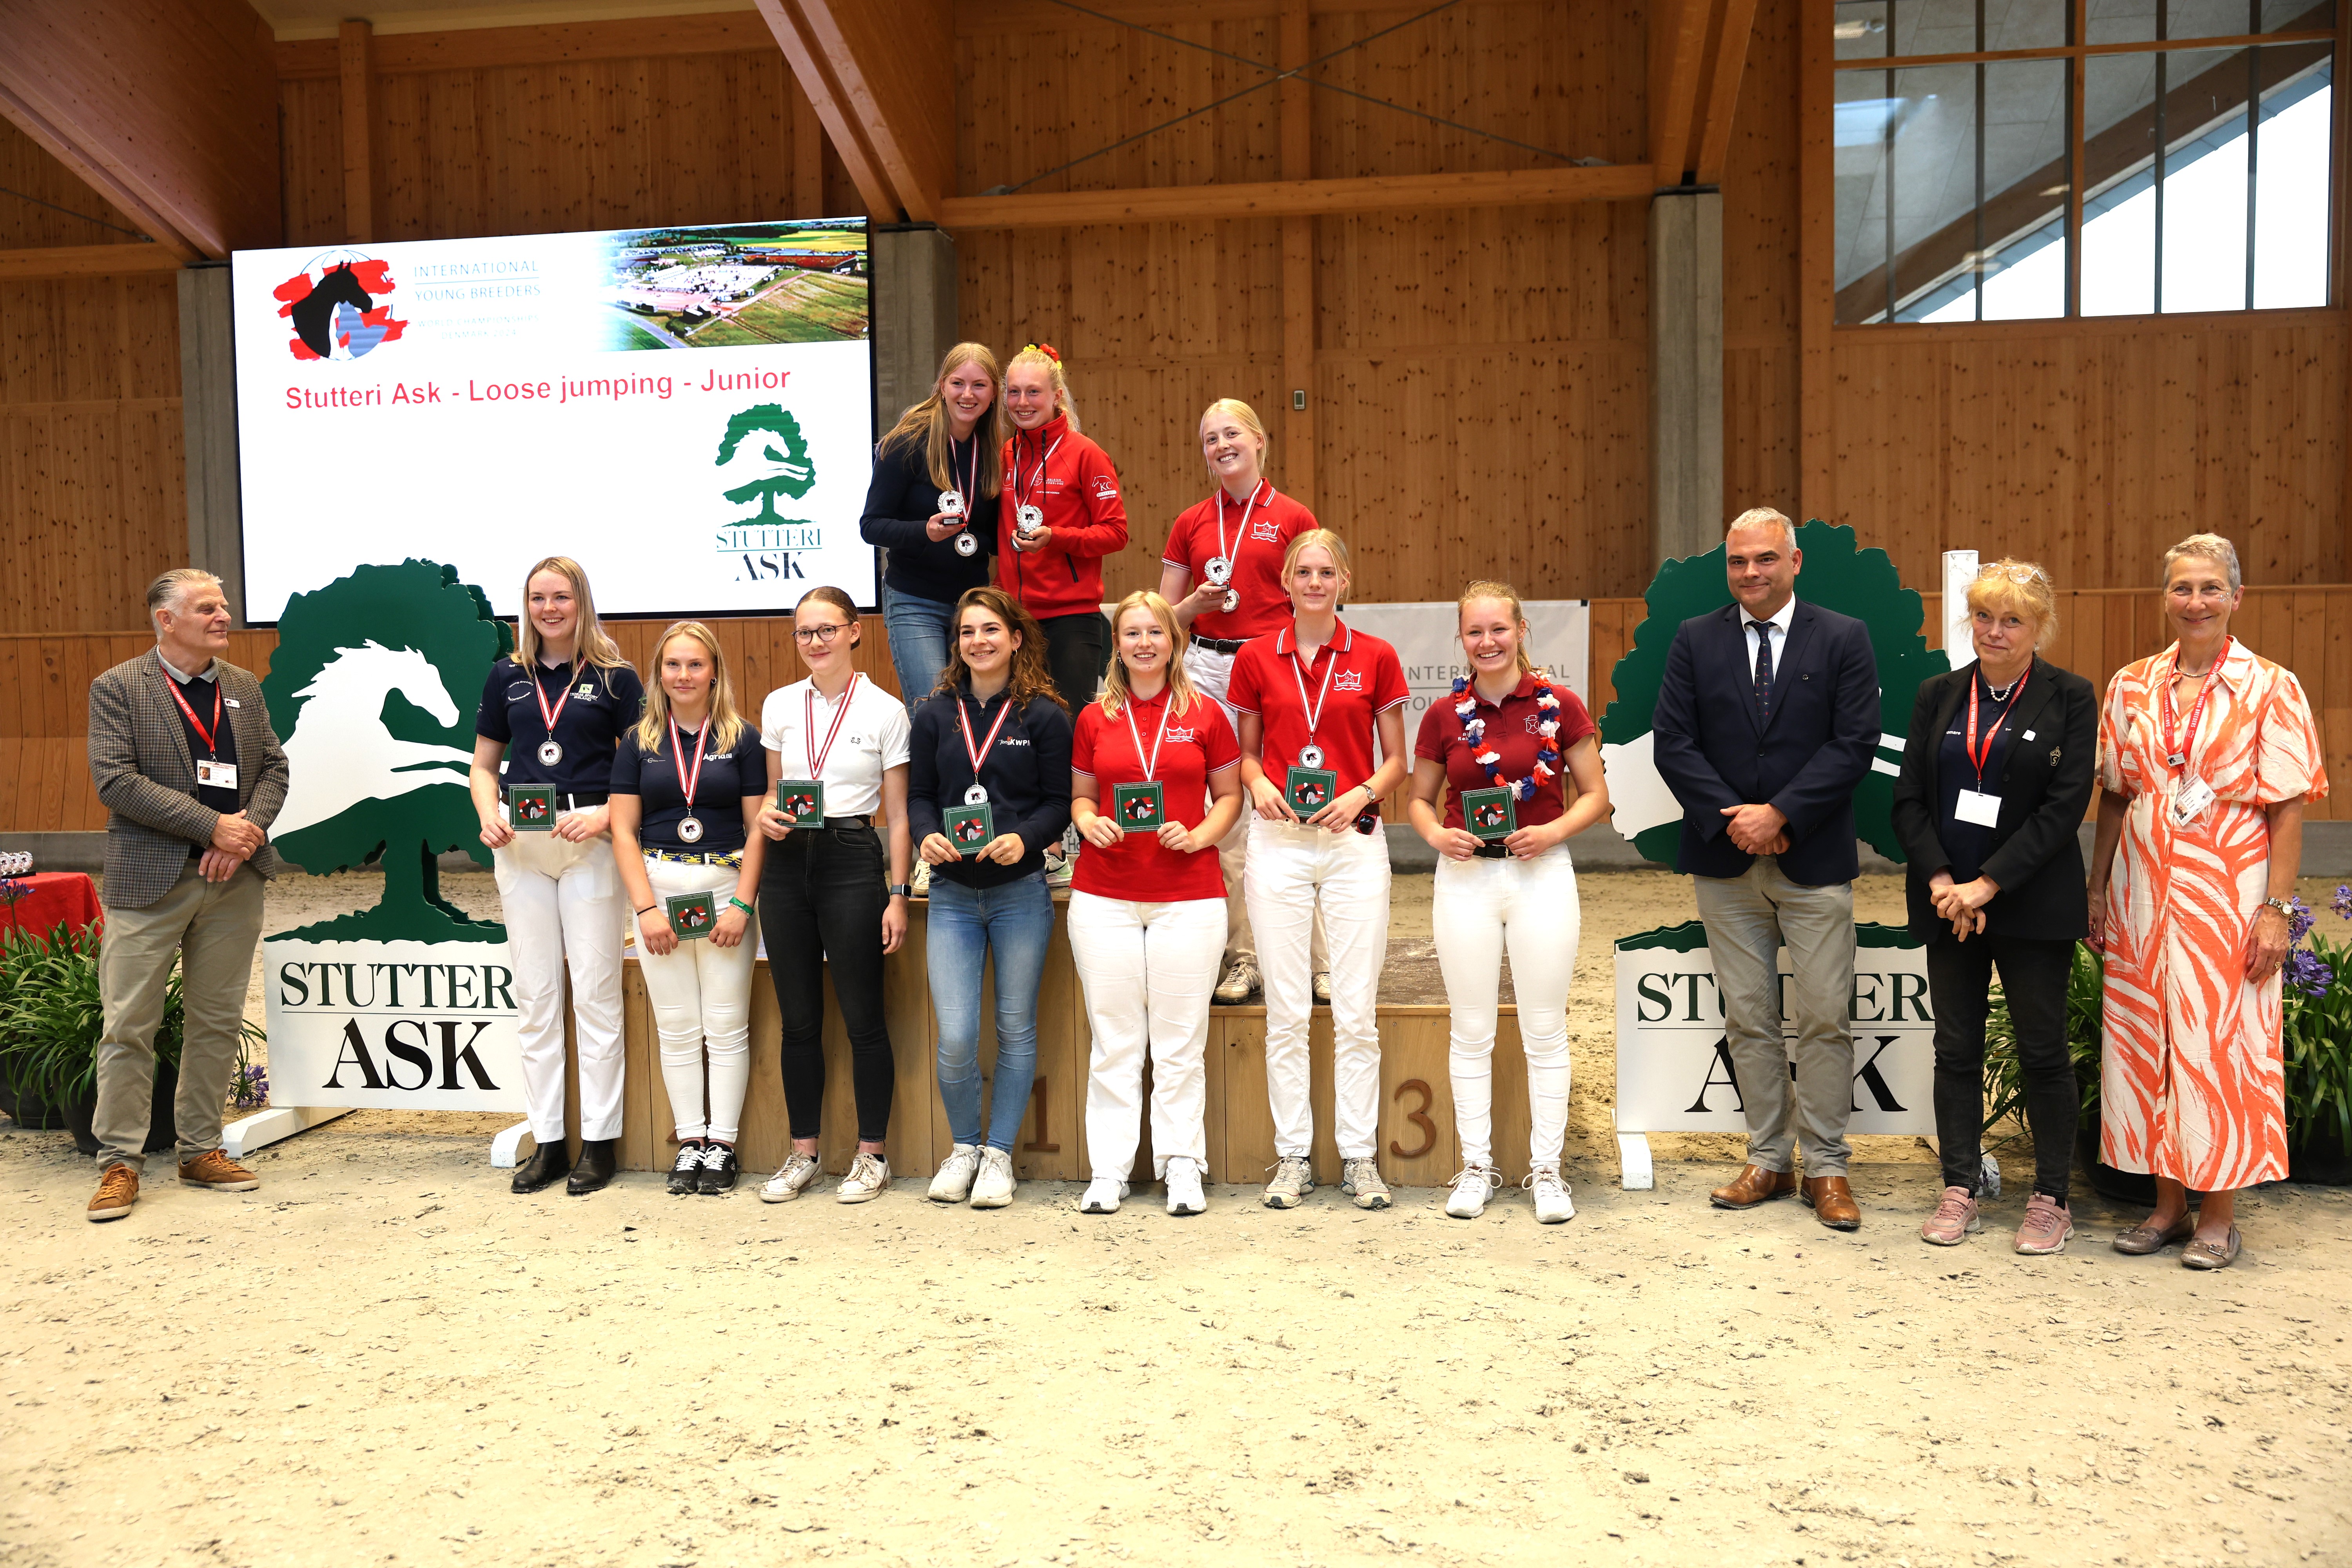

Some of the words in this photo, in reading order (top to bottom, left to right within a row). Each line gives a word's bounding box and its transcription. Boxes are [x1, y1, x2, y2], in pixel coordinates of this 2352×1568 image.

[415, 261, 538, 277] INTERNATIONAL
[415, 289, 465, 301] YOUNG
[471, 285, 540, 299] BREEDERS
[457, 314, 539, 326] CHAMPIONSHIPS
[442, 331, 489, 339] DENMARK
[287, 384, 381, 409] Stutteri
[392, 381, 441, 405] Ask
[470, 379, 550, 401] Loose
[560, 373, 671, 403] jumping
[701, 367, 791, 391] Junior
[1099, 481, 1112, 491] KC
[717, 528, 820, 548] STUTTERI
[735, 552, 806, 581] ASK
[171, 686, 183, 704] WARMBLOOD
[2196, 696, 2205, 708] YOUNG
[182, 703, 192, 715] DANISH
[2190, 709, 2201, 728] BREEDERS
[702, 753, 726, 761] Agria
[280, 962, 518, 1009] STUTTER
[322, 1017, 501, 1091] ASK
[1684, 1034, 1908, 1113] AK
[1023, 1075, 1060, 1151] 1
[1390, 1078, 1436, 1158] 3
